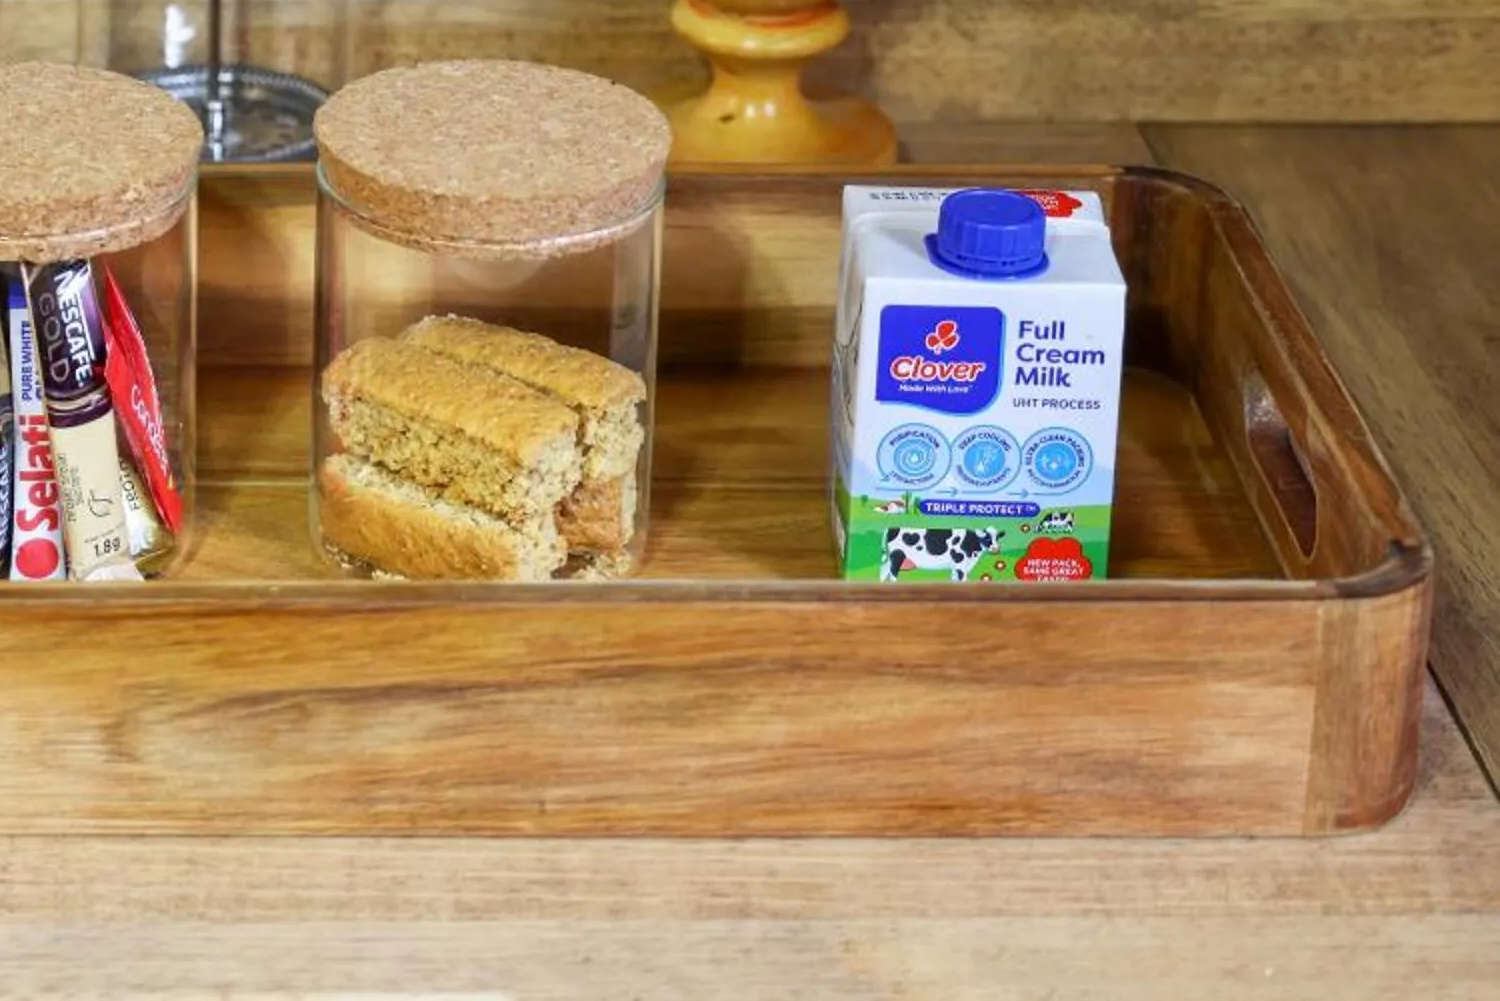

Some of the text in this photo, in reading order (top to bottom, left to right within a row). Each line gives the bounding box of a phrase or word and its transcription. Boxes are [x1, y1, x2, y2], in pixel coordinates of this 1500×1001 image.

[39, 292, 70, 383] GOLD
[1018, 320, 1065, 339] Full
[21, 320, 33, 401] PURE WHITE
[1016, 343, 1105, 365] Cream
[890, 355, 987, 381] Clover
[1015, 366, 1071, 387] Milk
[1012, 398, 1101, 410] UHT PROCESS
[17, 415, 60, 532] Selati
[925, 501, 1022, 515] TRIPLE PROTECT
